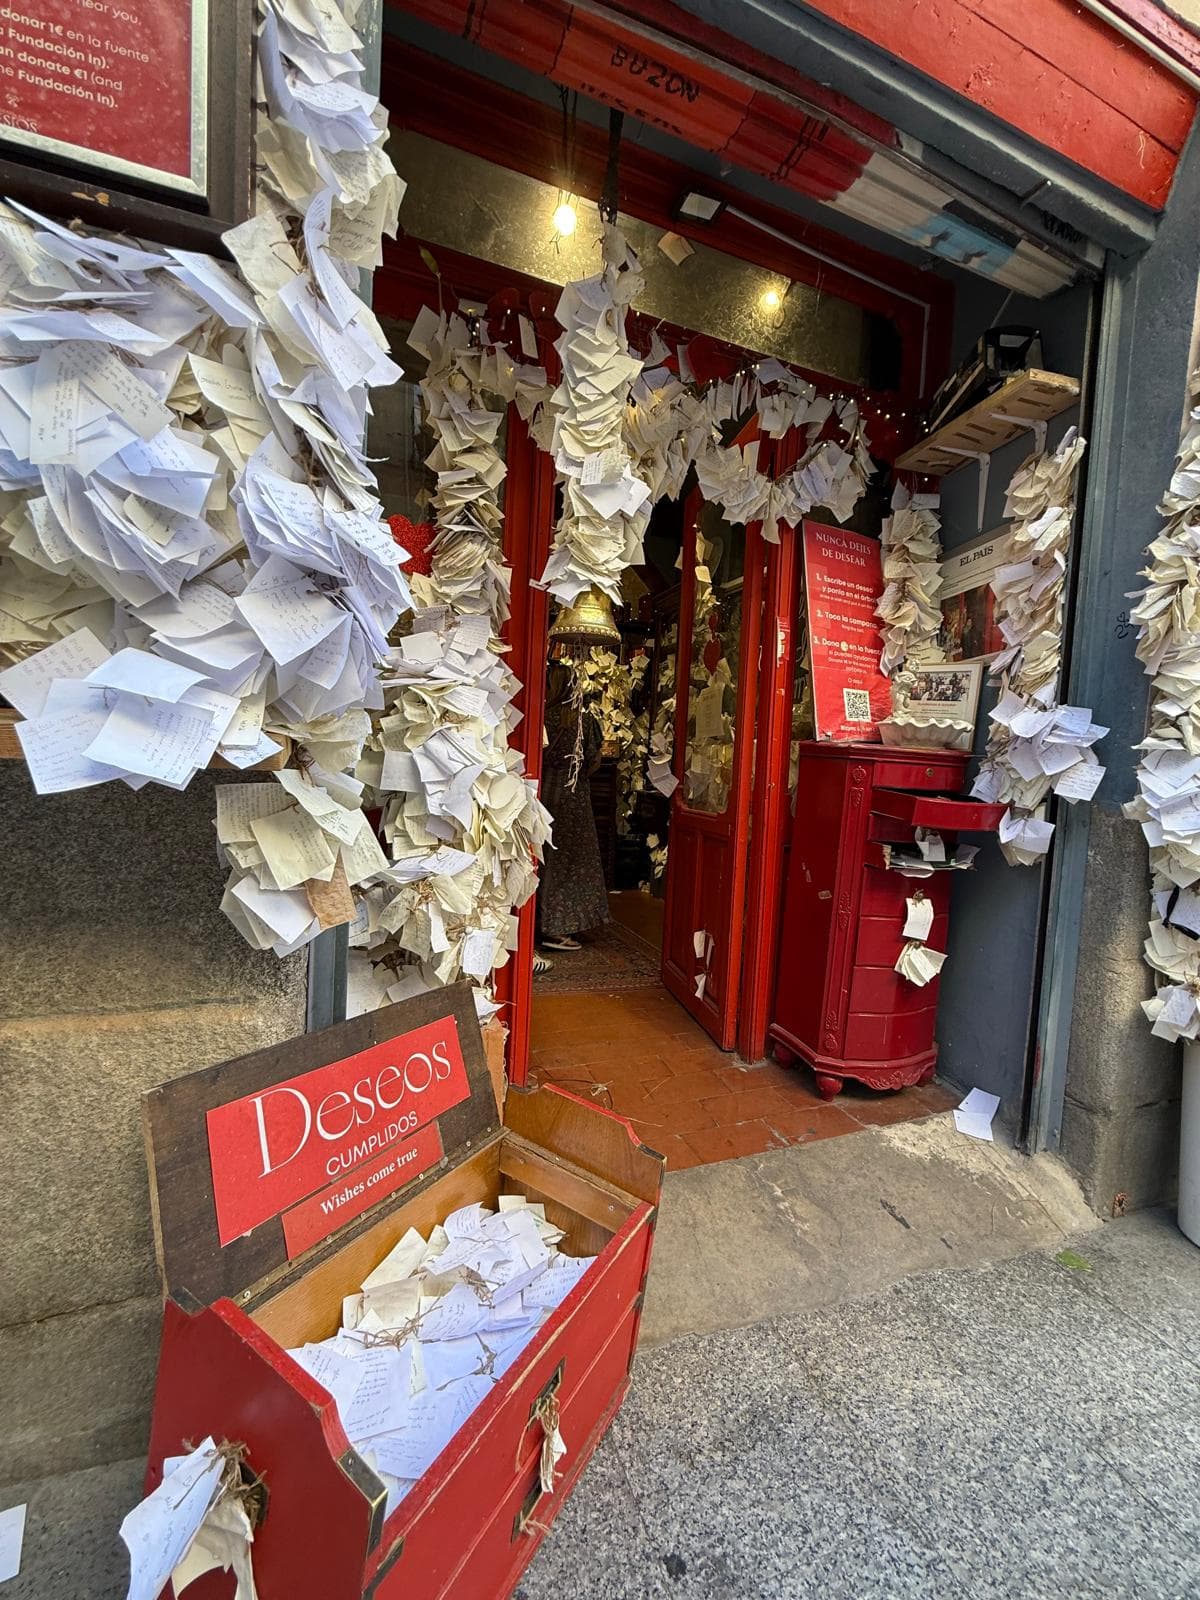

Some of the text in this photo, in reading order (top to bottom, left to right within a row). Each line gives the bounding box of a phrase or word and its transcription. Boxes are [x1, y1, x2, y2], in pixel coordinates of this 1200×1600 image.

[112, 8, 142, 25] you.
[0, 8, 46, 30] donar
[66, 30, 84, 43] en
[88, 34, 101, 48] la
[105, 40, 149, 63] fuente
[8, 28, 85, 61] Fundación
[17, 51, 71, 75] donate
[90, 72, 122, 91] (and
[18, 70, 93, 101] Fundación
[815, 531, 848, 549] NUNCA
[822, 547, 866, 567] DE DESEAR
[959, 555, 972, 567] EL
[823, 575, 846, 587] Escribe
[846, 581, 855, 589] un
[825, 611, 841, 621] Toca
[821, 637, 840, 648] Dona
[326, 1111, 418, 1176] CUMPLIDOS
[320, 1147, 418, 1216] Wishes come true
